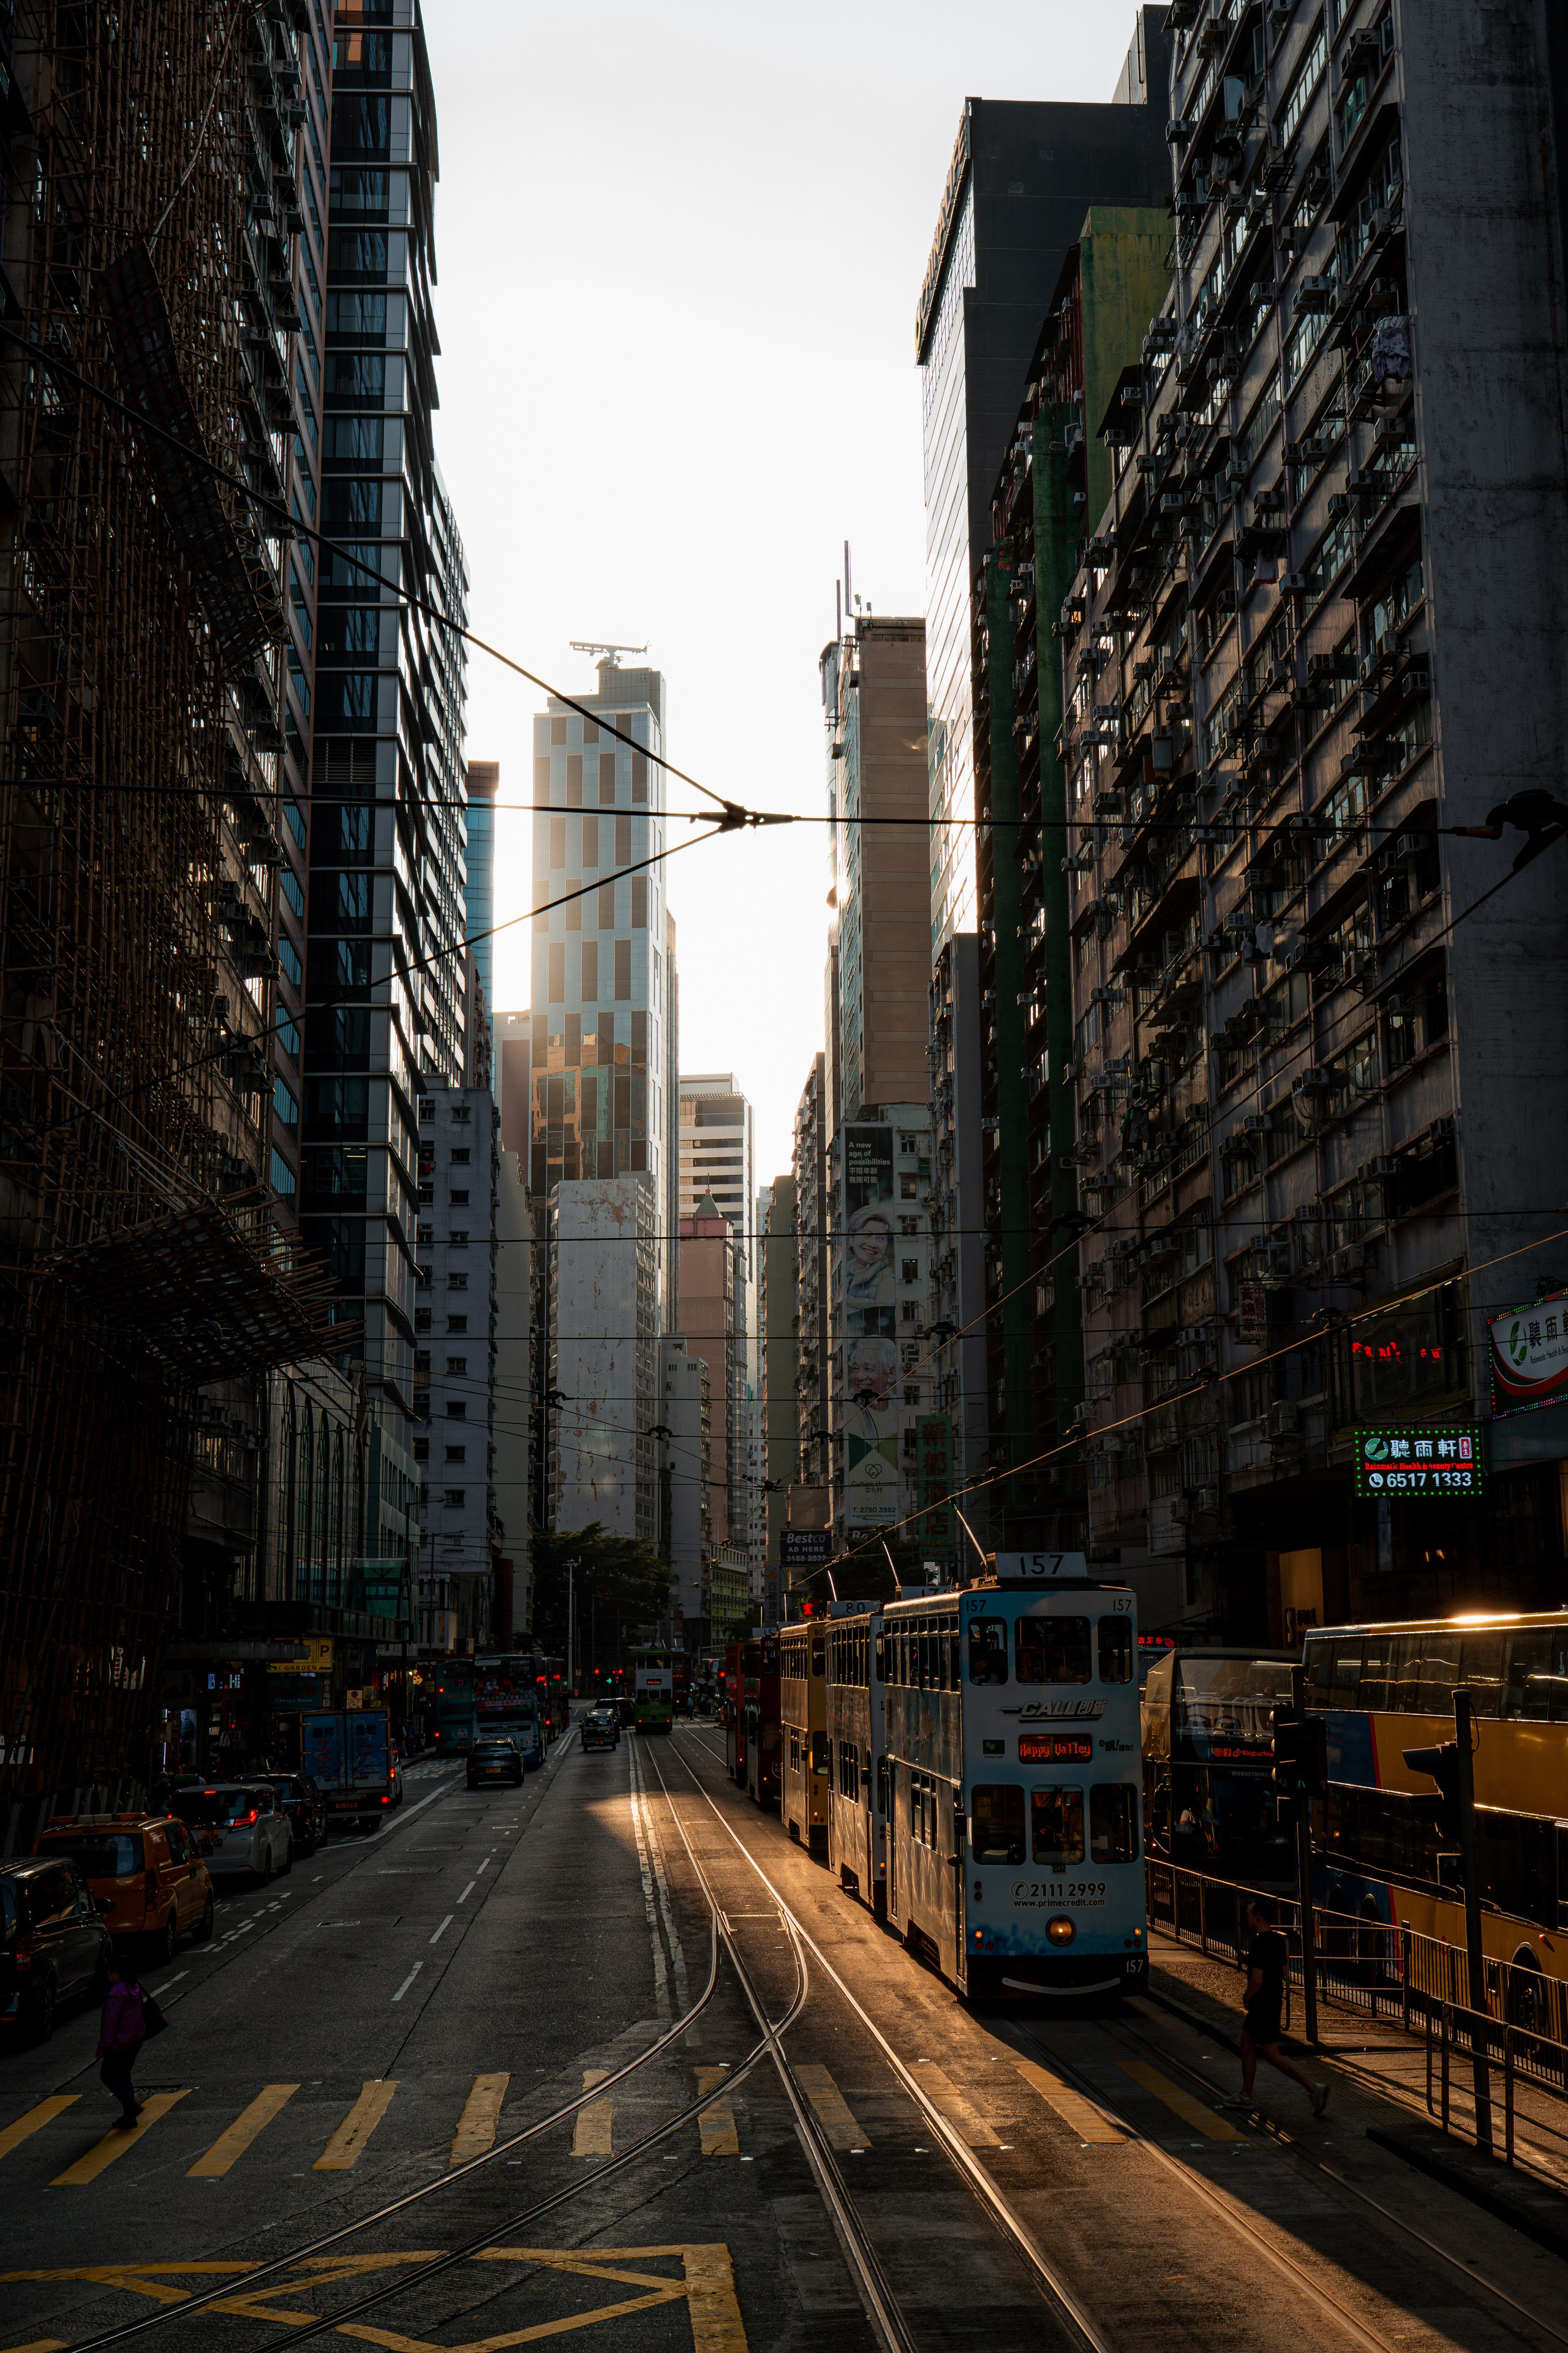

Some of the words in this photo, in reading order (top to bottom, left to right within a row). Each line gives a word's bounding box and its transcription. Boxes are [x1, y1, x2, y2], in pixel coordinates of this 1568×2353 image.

[1546, 1347, 1558, 1360] Health
[1390, 1438, 1457, 1459] 聽雨軒
[1400, 1462, 1422, 1470] Health
[922, 1422, 948, 1535] 新都酒店
[1387, 1472, 1427, 1487] 6517
[1432, 1471, 1472, 1487] 1333
[786, 1533, 826, 1544] Bestco
[1020, 1555, 1064, 1575] 157
[846, 1603, 865, 1614] 80
[966, 1600, 986, 1612] 157
[1113, 1599, 1132, 1611] 157
[320, 1645, 330, 1657] P
[1019, 1743, 1050, 1758] Happy
[1054, 1743, 1091, 1756] Valley
[1031, 1884, 1063, 1897] 2111
[1068, 1883, 1106, 1897] 2999
[1014, 1898, 1105, 1908] www.primecredit.com
[1126, 1959, 1144, 1973] 157
